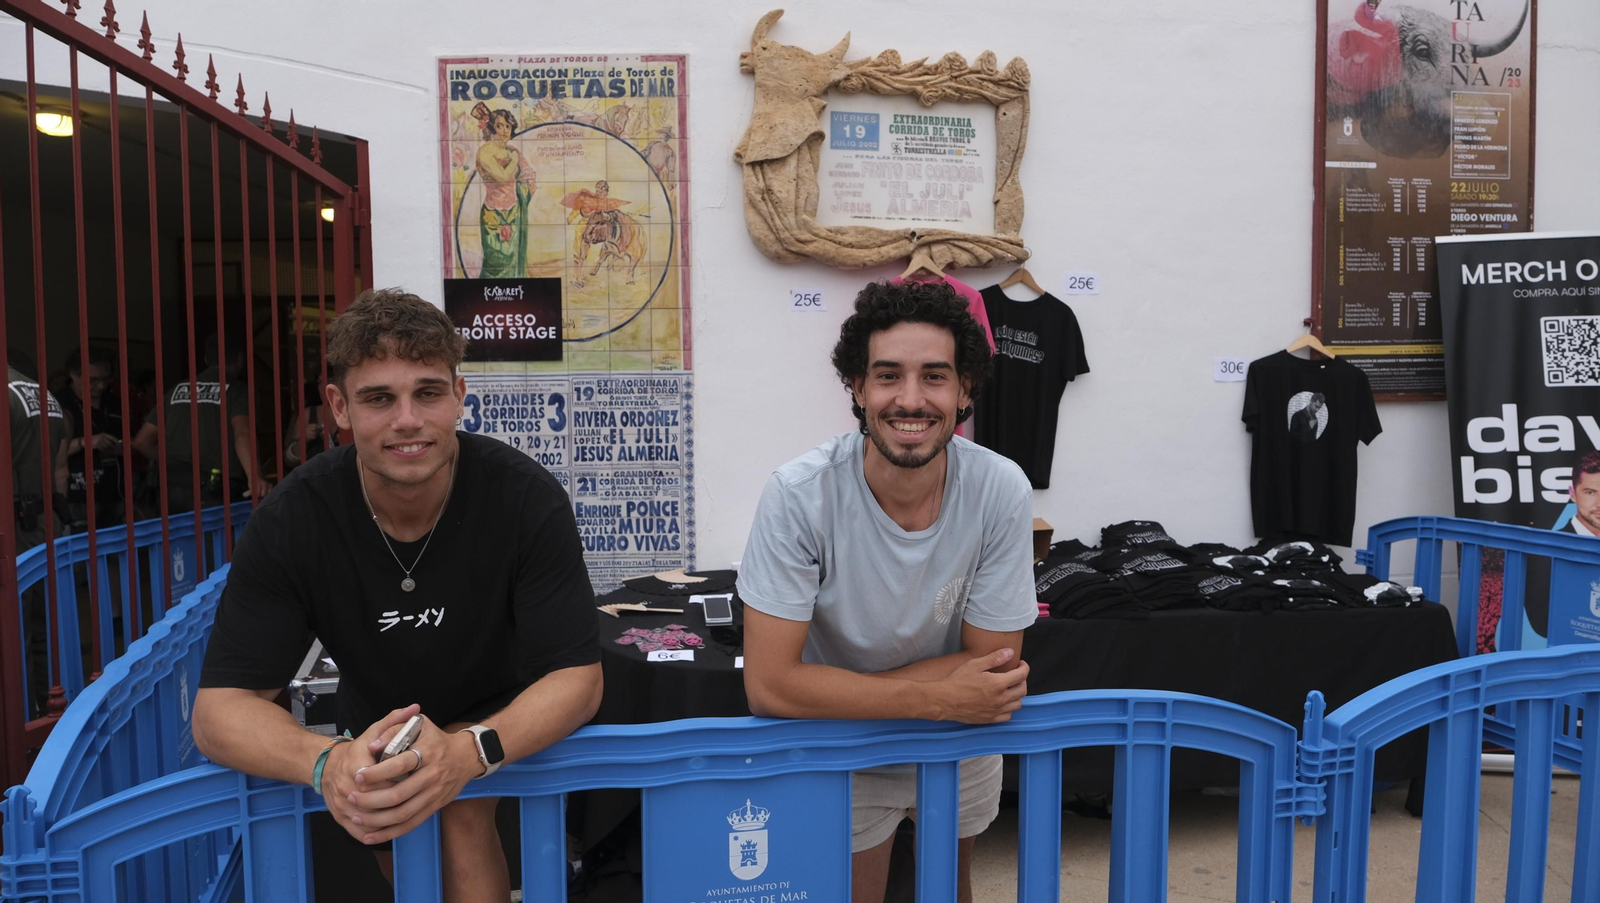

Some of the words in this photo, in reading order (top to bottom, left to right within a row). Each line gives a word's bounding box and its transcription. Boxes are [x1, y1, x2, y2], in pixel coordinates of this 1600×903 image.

[450, 67, 568, 80] INAUGURACIÓN
[573, 68, 604, 78] Plaza
[608, 67, 622, 77] de
[626, 68, 656, 77] Toros
[660, 66, 674, 76] de
[450, 78, 626, 101] ROQUETAS
[630, 78, 644, 97] DE
[648, 77, 675, 97] MAR
[834, 114, 876, 123] VIERNES
[893, 114, 972, 128] EXTRAORDINARIA
[844, 124, 866, 139] 19
[889, 125, 929, 136] CORRIDA
[933, 127, 944, 137] DE
[948, 128, 976, 138] TOROS
[861, 162, 903, 180] FINITO
[906, 163, 922, 180] DE
[1451, 213, 1478, 222] DIEGO
[1479, 214, 1518, 222] VENTURA
[1461, 260, 1566, 284] MERCH
[1576, 259, 1600, 280] O
[1069, 276, 1095, 290] 25€
[1513, 288, 1559, 298] COMPRA
[1561, 286, 1586, 296] AQUÍ
[794, 293, 821, 306] 25€
[472, 314, 536, 327] ACCESO
[509, 326, 556, 339] STAGE
[1220, 361, 1244, 374] 30€
[597, 379, 679, 387] EXTRAORDINARIA
[483, 394, 545, 406] GRANDES
[574, 386, 594, 401] 19
[464, 394, 482, 433] 3
[483, 407, 545, 420] CORRIDAS
[547, 392, 567, 432] 3
[574, 411, 617, 427] RIVERA
[483, 421, 498, 433] DE
[501, 420, 541, 433] TOROS
[527, 436, 541, 448] 20
[544, 440, 550, 452] y
[553, 436, 566, 449] 21
[574, 437, 601, 445] LOPEZ
[535, 452, 562, 466] 2002
[574, 446, 613, 462] JESUS
[618, 445, 679, 461] ALMERIA
[577, 477, 596, 492] 21
[575, 502, 622, 518] ENRIQUE
[626, 500, 679, 517] PONCE
[576, 518, 616, 526] EDUARDO
[618, 518, 680, 534] MIURA
[634, 535, 680, 551] VIVAS
[658, 652, 681, 660] 6€
[706, 882, 777, 896] AYUNTAMIENTO
[780, 881, 791, 889] DE
[780, 891, 808, 903] MAR
